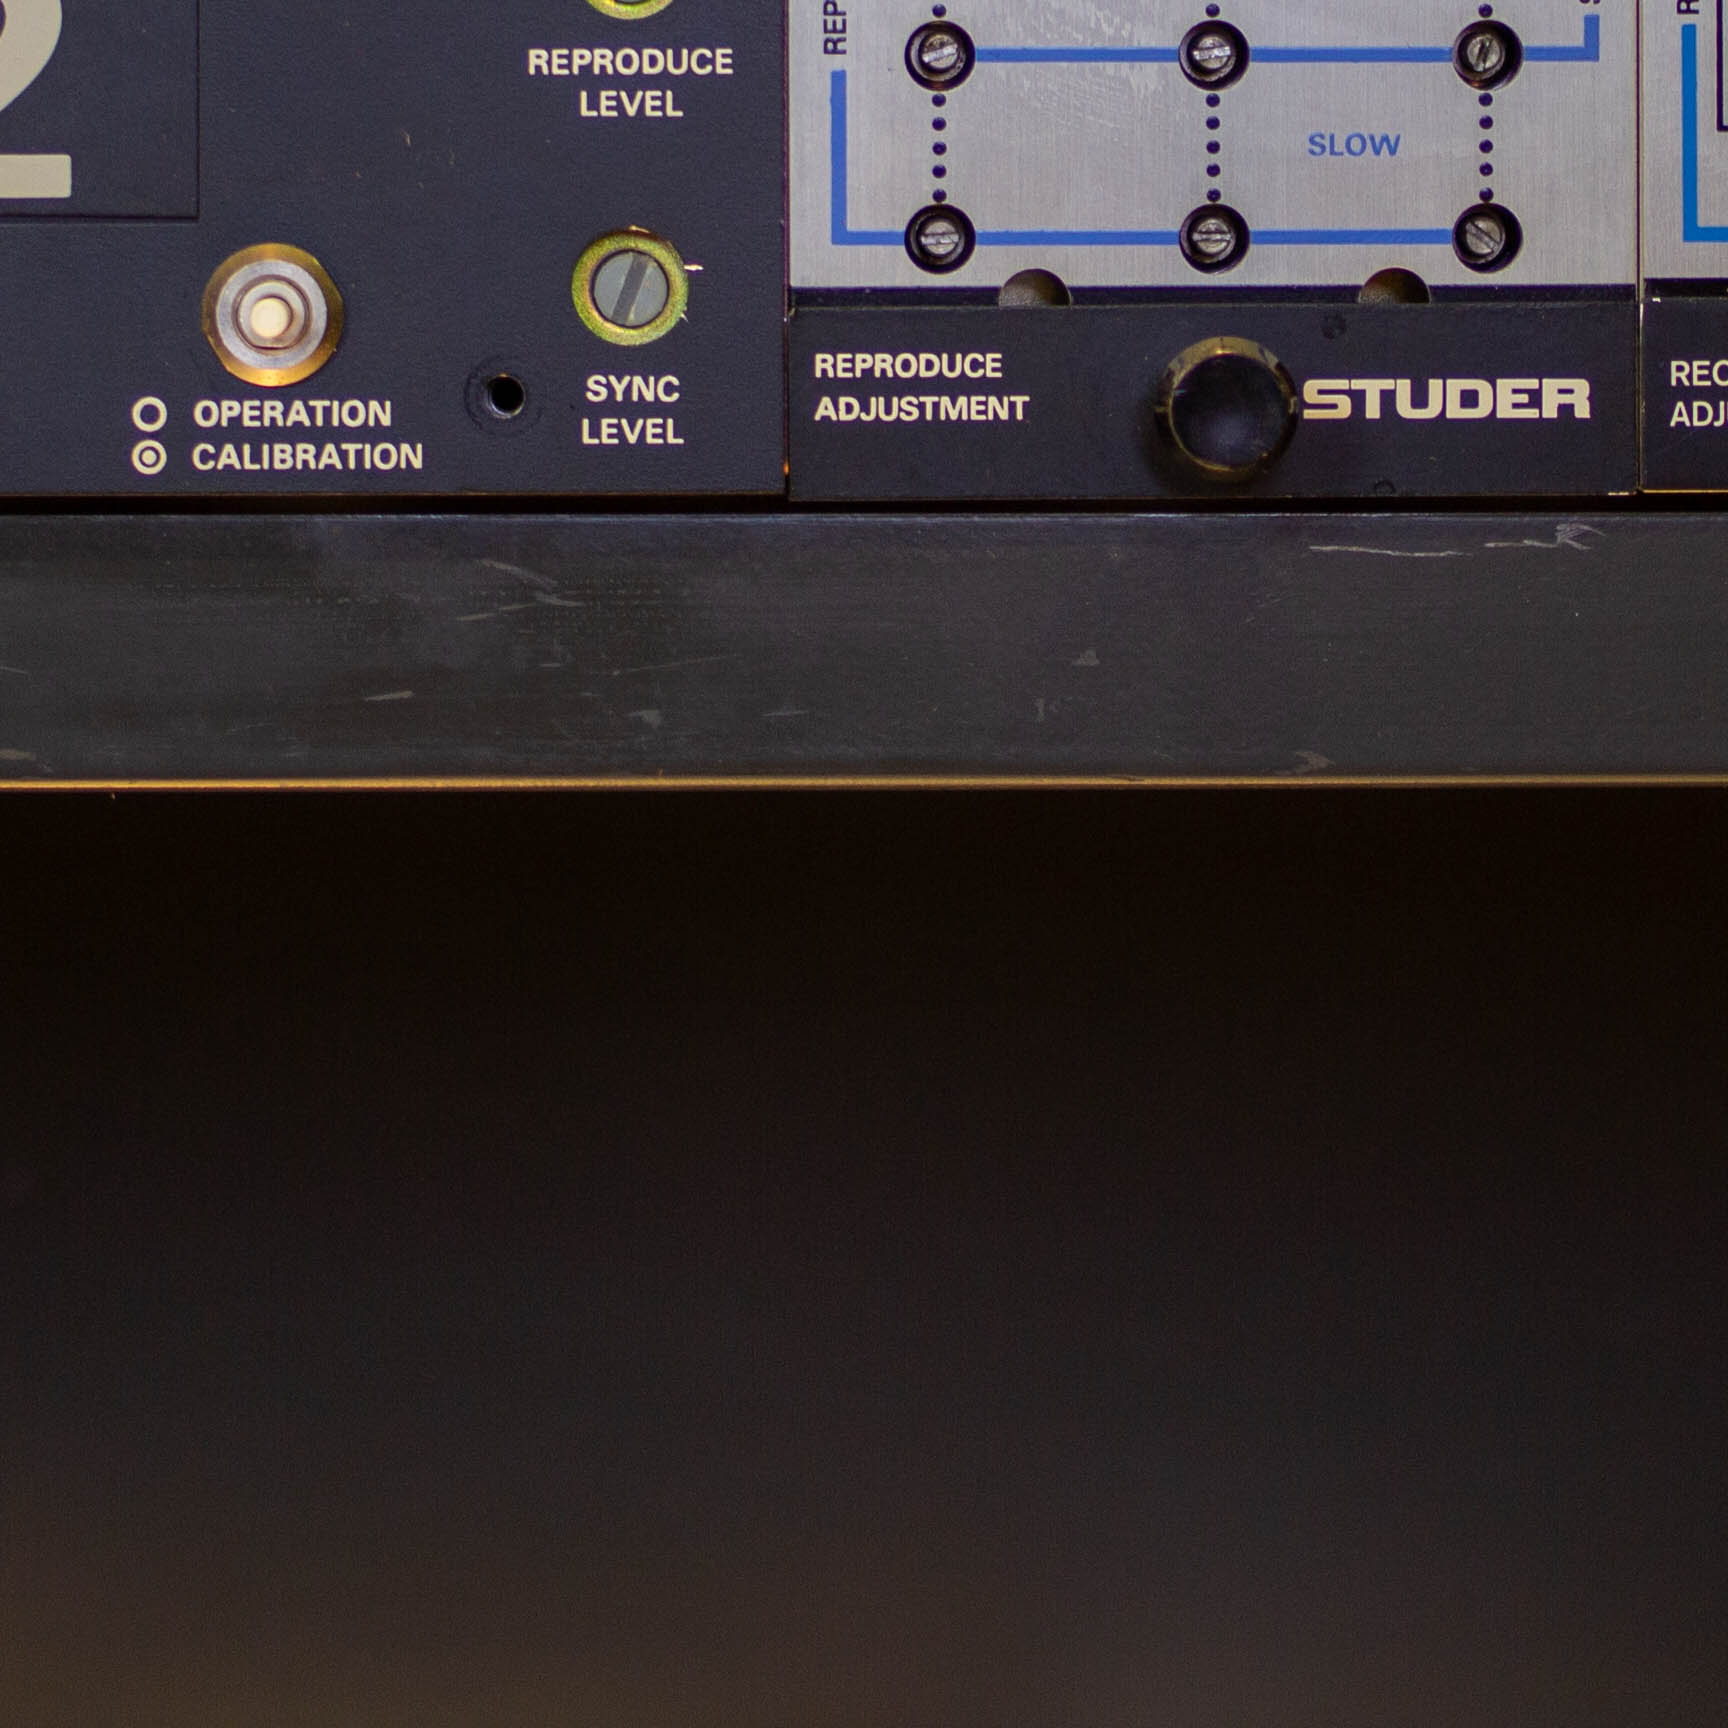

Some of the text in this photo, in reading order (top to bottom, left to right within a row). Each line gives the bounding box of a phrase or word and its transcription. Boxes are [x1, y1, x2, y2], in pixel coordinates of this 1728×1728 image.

[528, 47, 734, 76] REPRODUCE
[580, 89, 684, 117] LEVEL
[1308, 132, 1401, 157] SLOW
[814, 352, 1003, 379] REPRODUCE
[585, 374, 680, 403] SYNC
[1302, 377, 1591, 420] STUDER
[193, 399, 392, 428] OPERATION
[814, 395, 1031, 422] ADJUSTMENT
[582, 417, 685, 445] LEVEL
[192, 442, 423, 471] CALIBRATION
